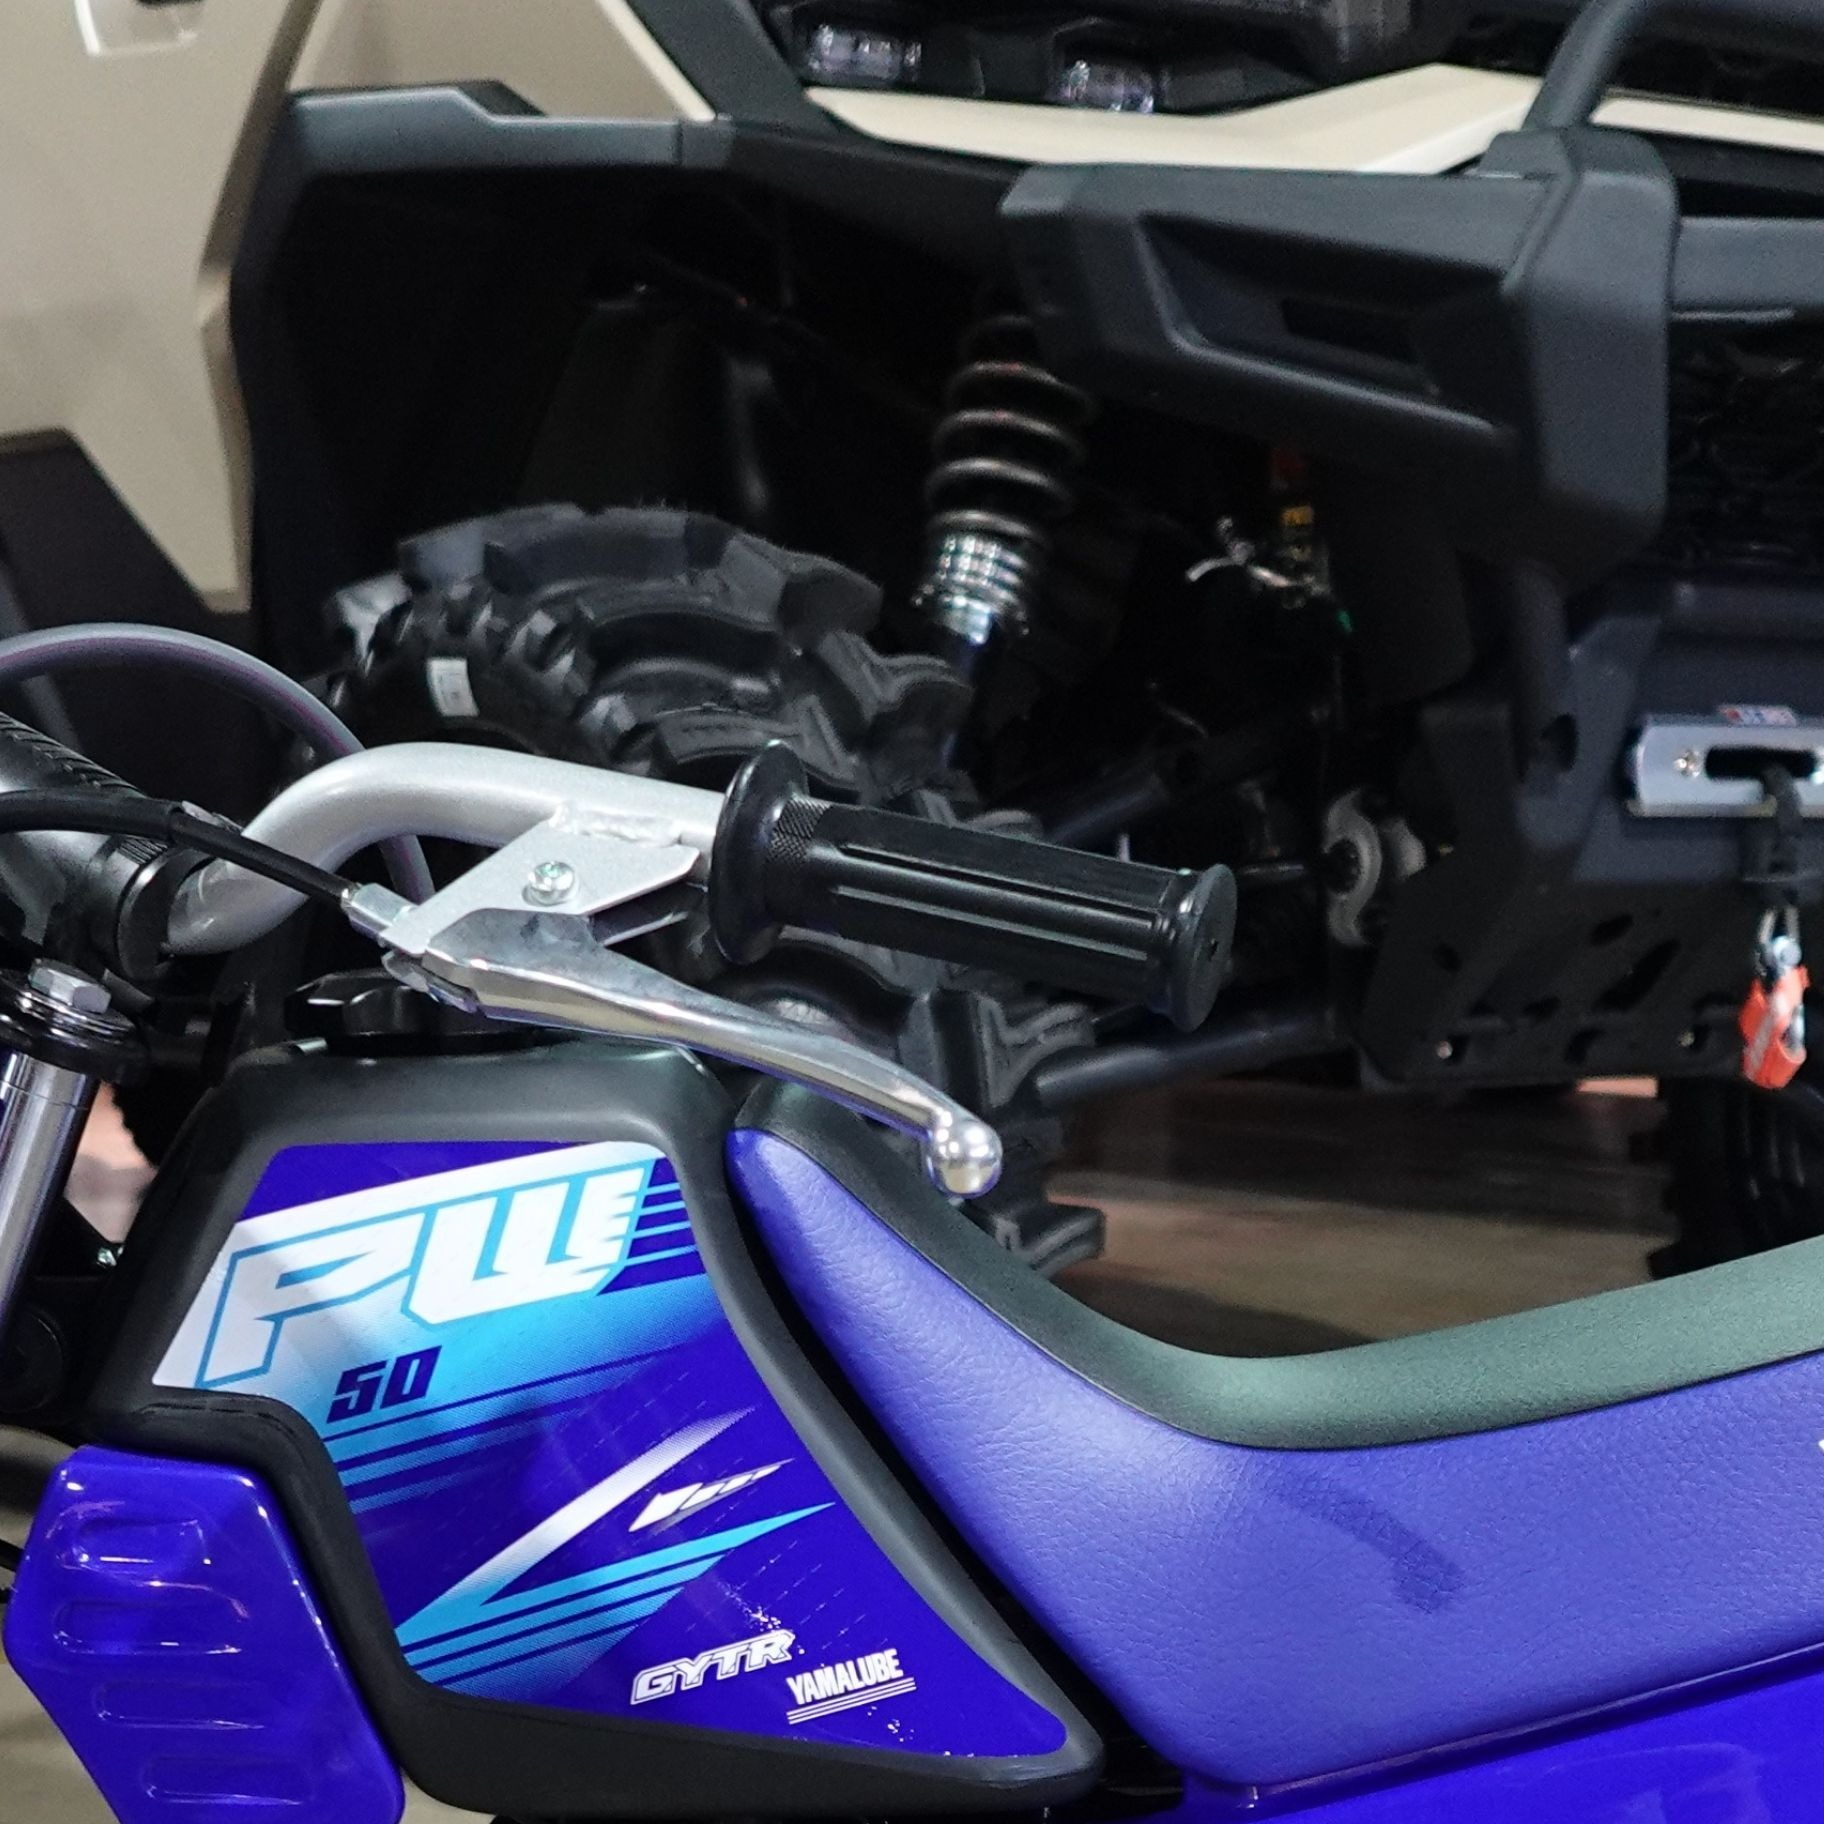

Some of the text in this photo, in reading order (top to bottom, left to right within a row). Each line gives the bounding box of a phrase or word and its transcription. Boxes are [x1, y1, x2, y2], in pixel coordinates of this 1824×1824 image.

[198, 1163, 648, 1388] PW
[326, 1345, 443, 1424] 50
[629, 1628, 796, 1705] GYTR
[785, 1648, 905, 1705] YAMALUBE
